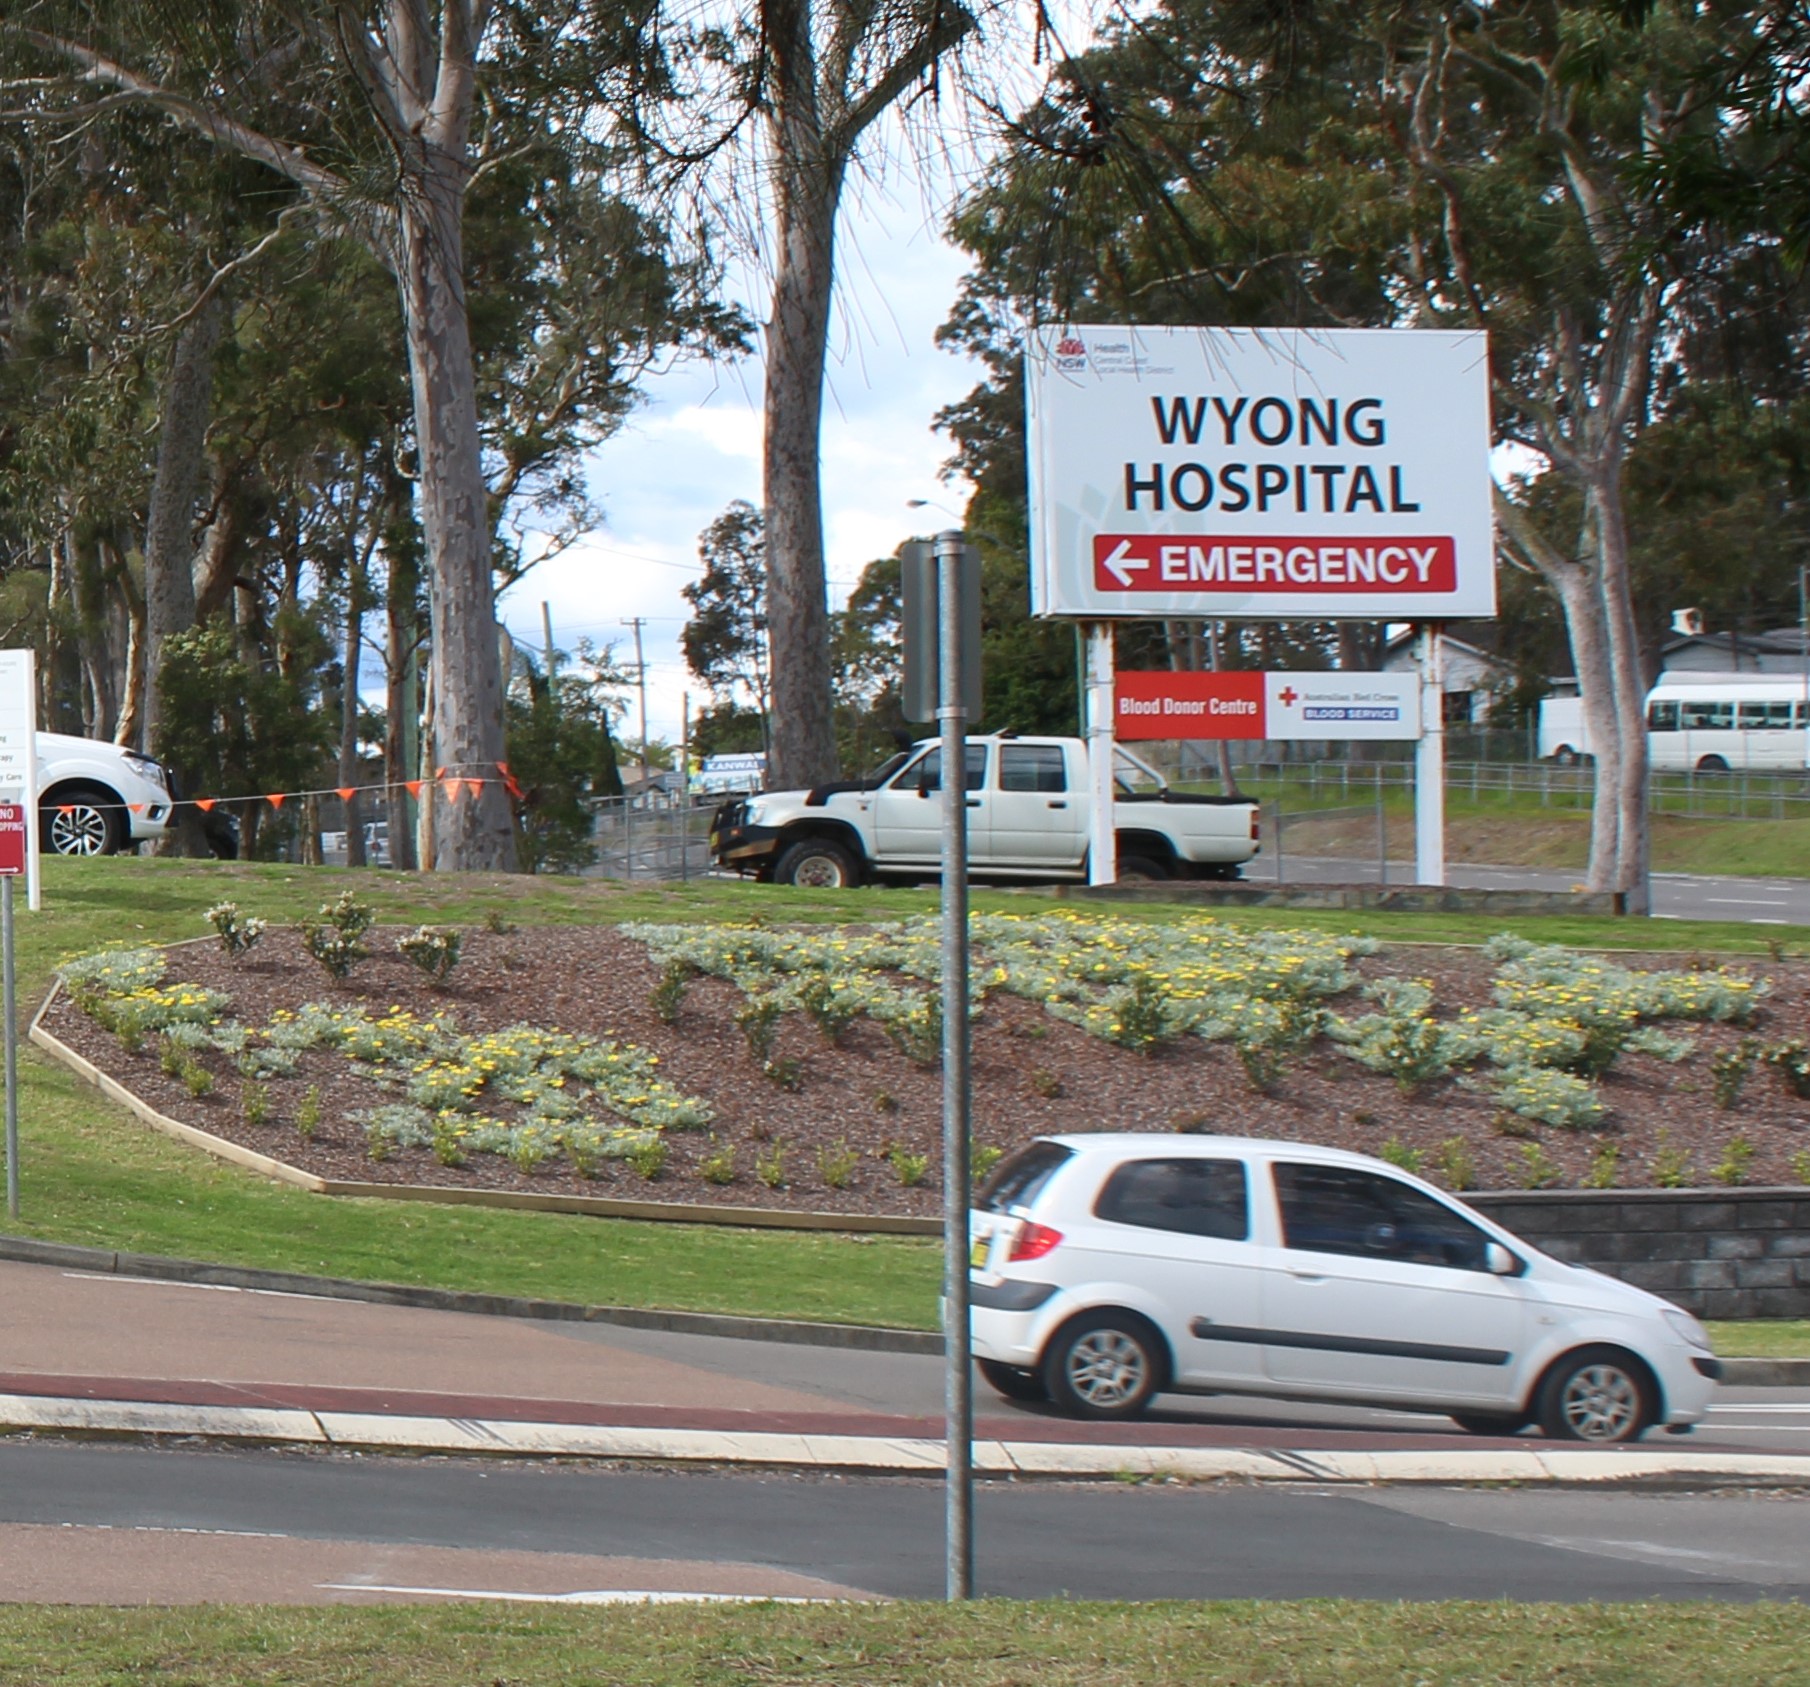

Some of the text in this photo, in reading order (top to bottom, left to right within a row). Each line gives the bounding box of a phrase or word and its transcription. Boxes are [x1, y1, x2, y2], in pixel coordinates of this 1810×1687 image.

[1057, 358, 1086, 369] NSW
[1151, 396, 1386, 446] WYONG
[1124, 462, 1420, 513] HOSPITAL
[1160, 545, 1438, 583] EMERGENCY
[1120, 698, 1257, 715] Blood Donor Centre
[1305, 709, 1396, 718] BLOOD SERVICE
